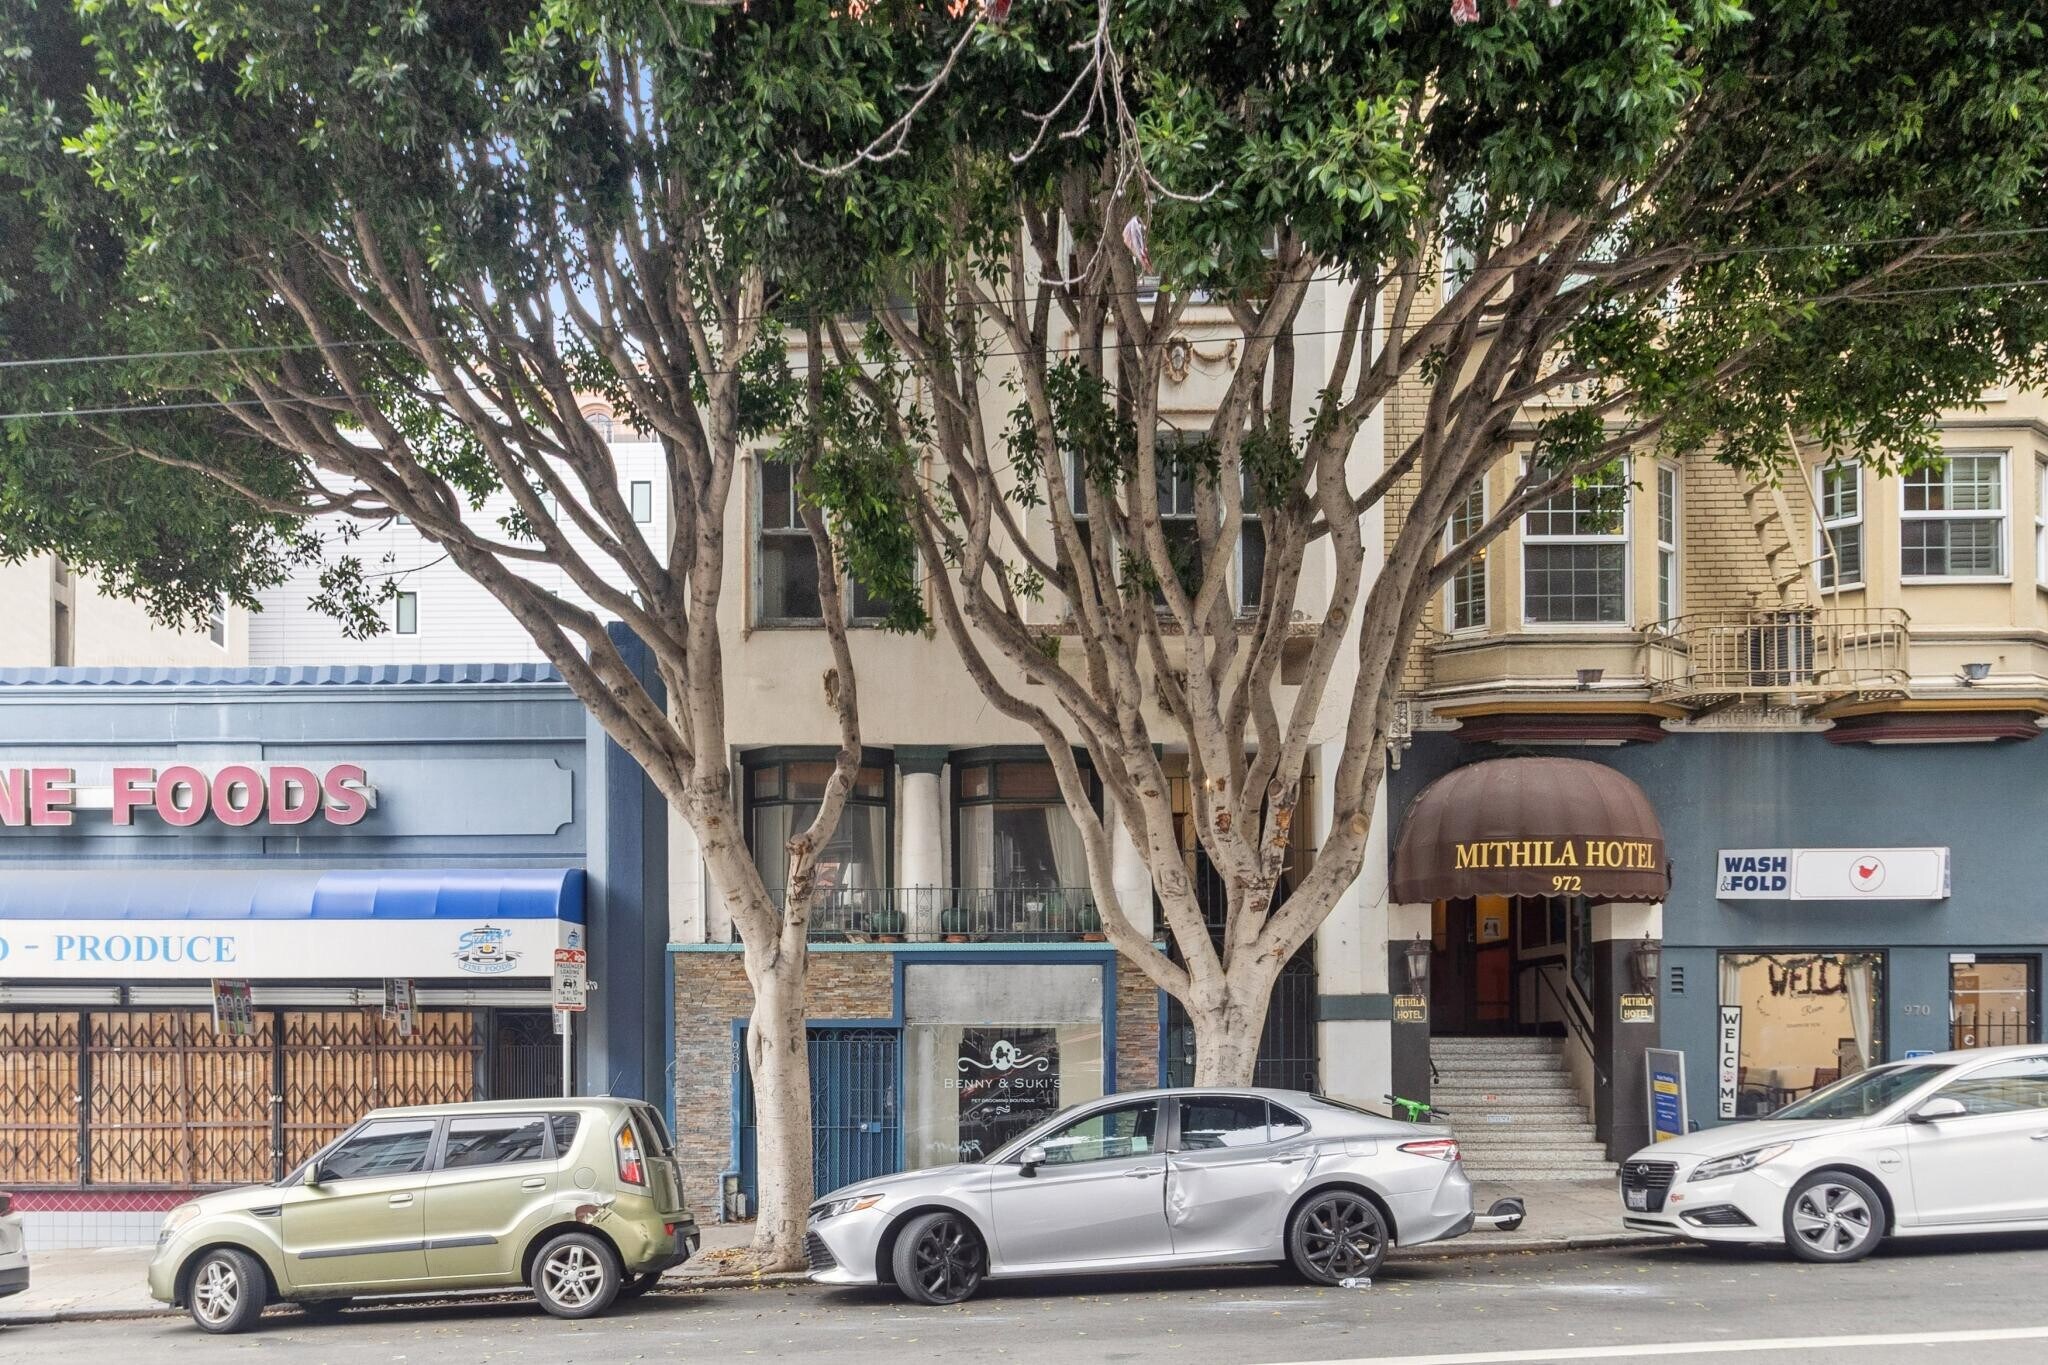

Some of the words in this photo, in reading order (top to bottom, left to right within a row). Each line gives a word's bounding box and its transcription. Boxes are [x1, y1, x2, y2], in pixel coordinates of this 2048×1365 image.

[112, 764, 370, 827] FOODS
[1455, 840, 1578, 869] MITHILA
[1585, 840, 1656, 869] HOTEL
[1724, 856, 1787, 873] WASH
[1552, 875, 1582, 891] 972
[1730, 876, 1787, 891] FOLD
[54, 934, 237, 963] PRODUCE
[1394, 998, 1425, 1007] MITHILA
[1621, 997, 1653, 1007] MITHILA
[1397, 1010, 1423, 1019] HOTEL
[1624, 1009, 1650, 1018] HOTEL
[1904, 1004, 1931, 1016] 970
[944, 1078, 993, 1089] BENNY
[998, 1079, 1009, 1089] &
[1014, 1078, 1062, 1089] SUKI'S
